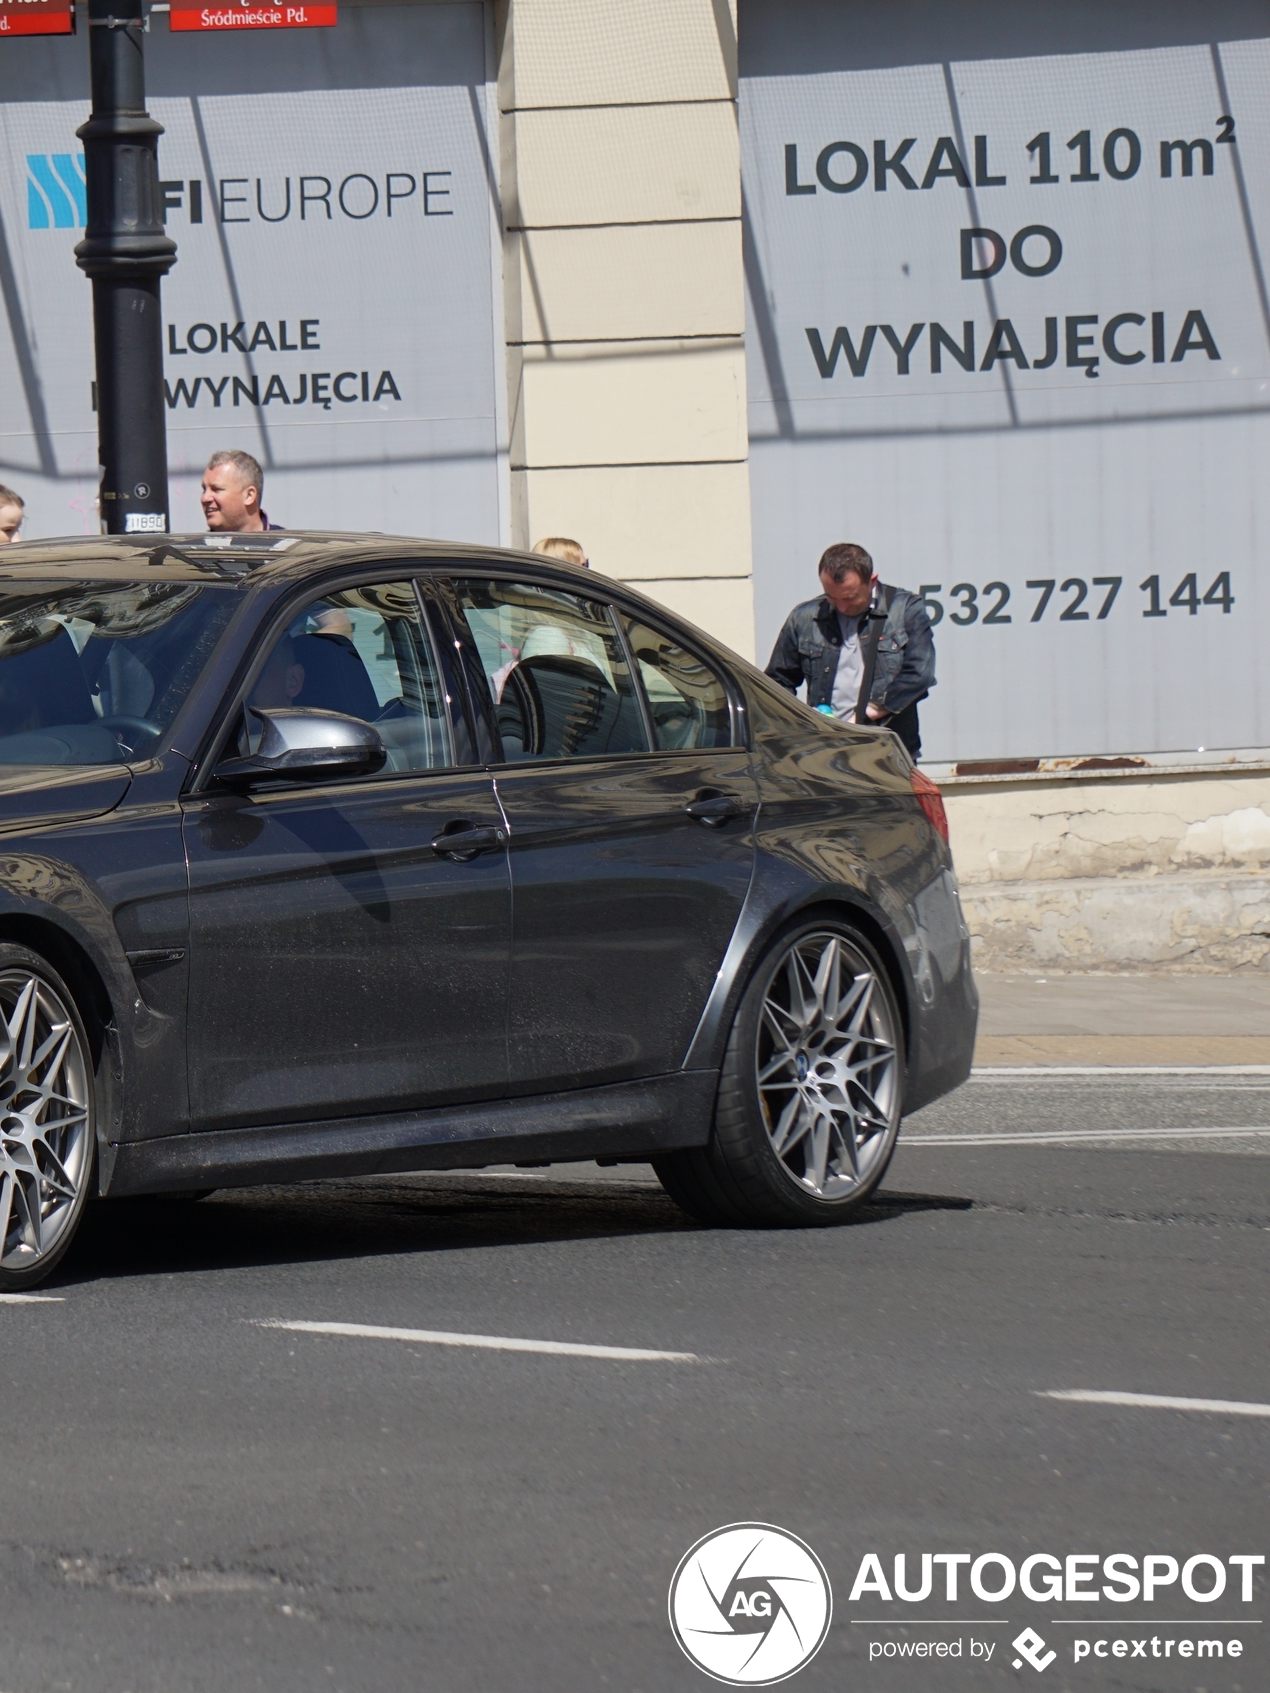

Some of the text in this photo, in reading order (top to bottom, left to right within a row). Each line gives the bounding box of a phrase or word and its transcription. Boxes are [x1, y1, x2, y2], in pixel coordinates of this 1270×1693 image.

[201, 7, 308, 27] Śródmieście Pd.
[784, 133, 1006, 196] LOKAL
[1025, 127, 1142, 184] 110
[159, 170, 454, 225] FI EUROPE
[959, 224, 1064, 280] DO
[168, 319, 321, 355] LOKALE
[805, 309, 1220, 379] WYNAJĘCIA
[165, 371, 402, 410] WYNAJĘCIA
[918, 571, 1235, 627] 532 727 144
